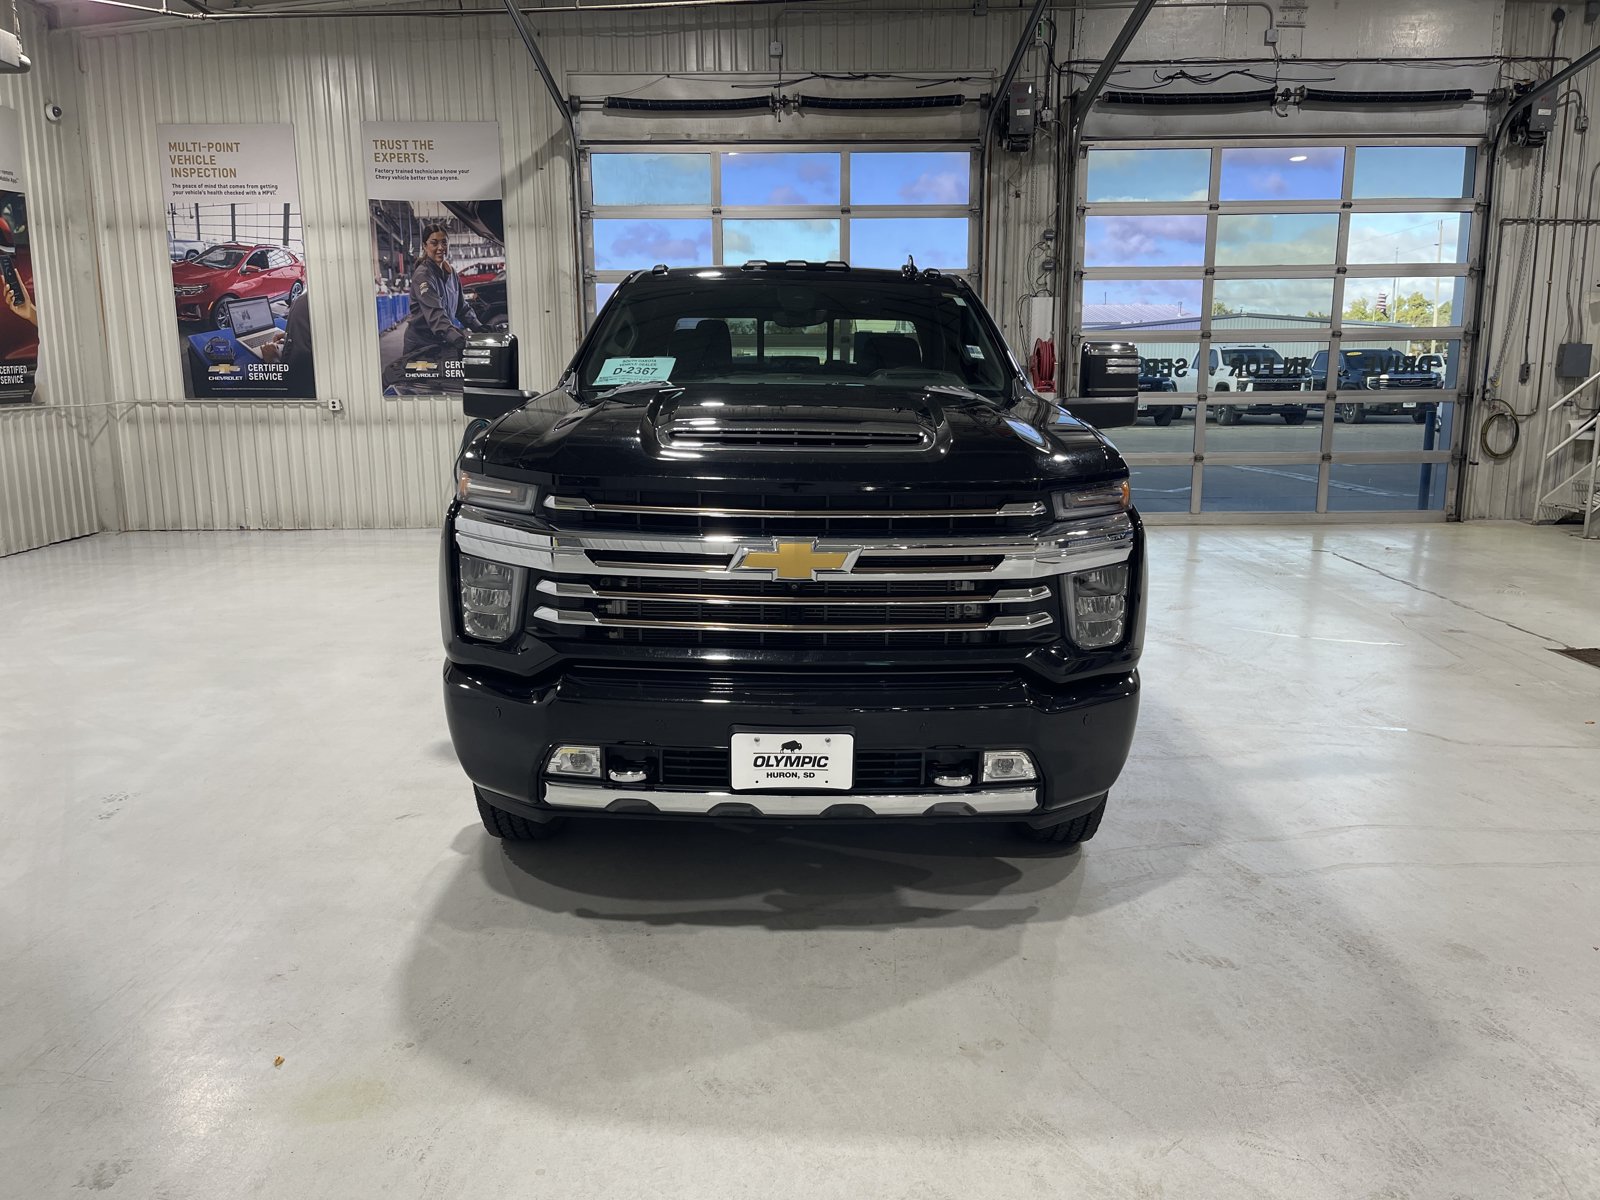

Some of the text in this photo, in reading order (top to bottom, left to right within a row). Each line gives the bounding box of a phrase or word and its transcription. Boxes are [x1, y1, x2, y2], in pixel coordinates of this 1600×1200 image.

[168, 142, 240, 153] MULTI-POINT
[373, 140, 434, 151] TRUST THE
[169, 154, 217, 166] VEHICLE
[374, 152, 429, 163] EXPERTS.
[170, 167, 237, 178] INSPECTION
[0, 365, 28, 374] CERTIFIED
[247, 363, 290, 372] CERTIFIED
[612, 366, 658, 376] D-2367
[0, 375, 24, 384] SERVICE
[248, 372, 283, 381] SERVICE
[753, 755, 829, 768] OLYMPIC
[766, 772, 801, 780] HURON,
